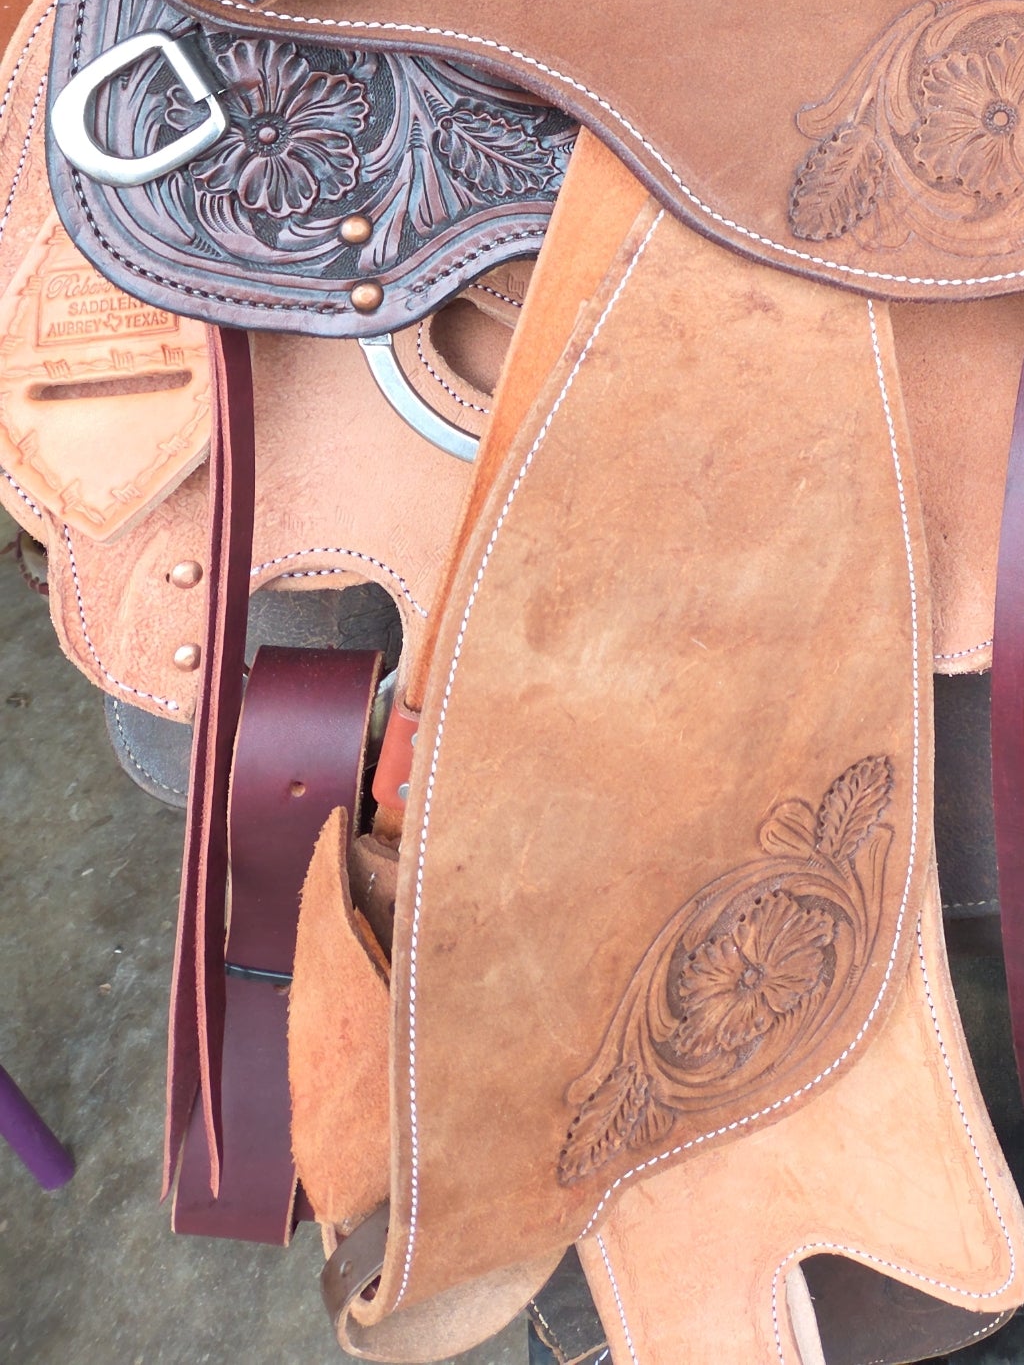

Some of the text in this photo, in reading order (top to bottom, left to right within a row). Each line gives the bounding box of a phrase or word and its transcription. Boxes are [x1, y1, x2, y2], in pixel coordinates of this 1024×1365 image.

[68, 296, 145, 316] SADDLER
[47, 312, 169, 337] AUBREY TEXAS
